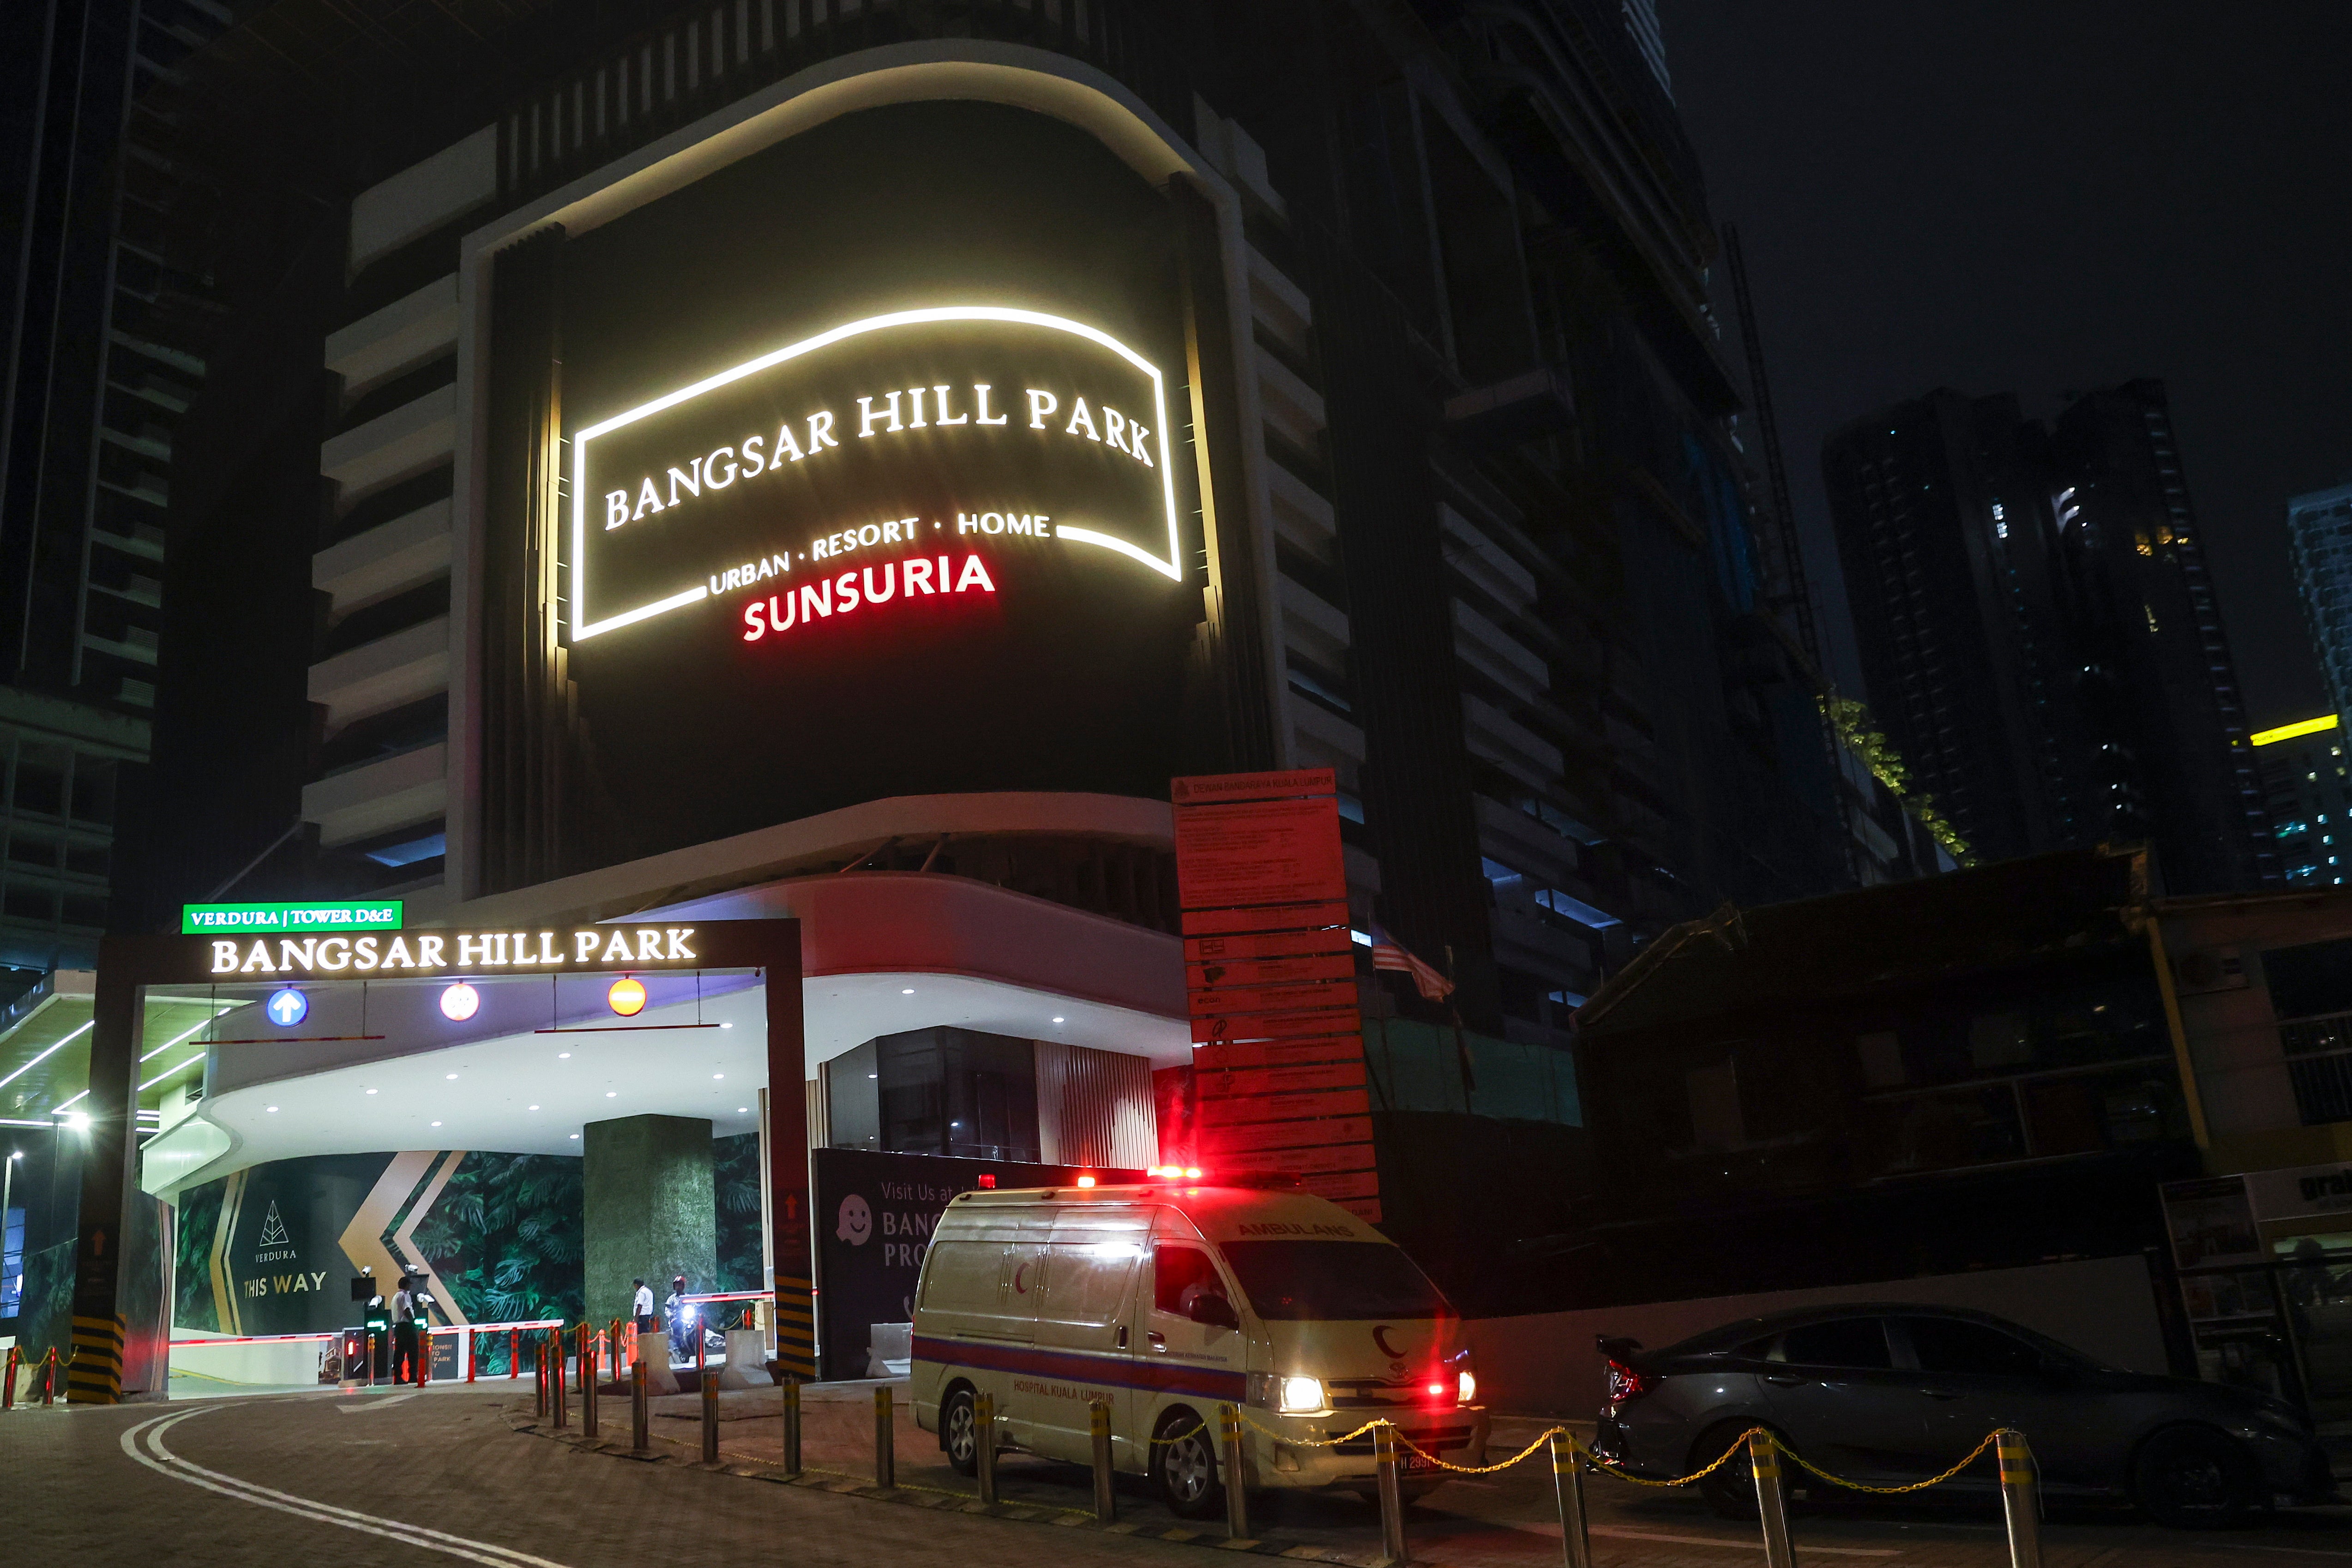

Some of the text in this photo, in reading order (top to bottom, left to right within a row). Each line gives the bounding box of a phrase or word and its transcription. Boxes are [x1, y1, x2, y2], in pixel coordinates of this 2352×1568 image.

[604, 385, 1154, 531] BANGSAR HILL PARK
[710, 513, 1050, 595] URBAN RESORT HOME
[743, 554, 995, 642] SUNSURIA
[1193, 776, 1333, 793] DEWAN BANDARAYA KUALA LUMPUR
[192, 909, 392, 925] VERDURA TOWER D&E
[211, 929, 696, 972] BANGSAR HILL PARK
[881, 1182, 912, 1200] Visit
[918, 1184, 934, 1201] Us
[940, 1185, 952, 1201] at
[1239, 1224, 1354, 1237] AMBULANS
[255, 1250, 296, 1263] VERDURA
[244, 1272, 326, 1298] THIS WAY
[1014, 1380, 1114, 1405] HOSPITAL KUALA LUMPUR
